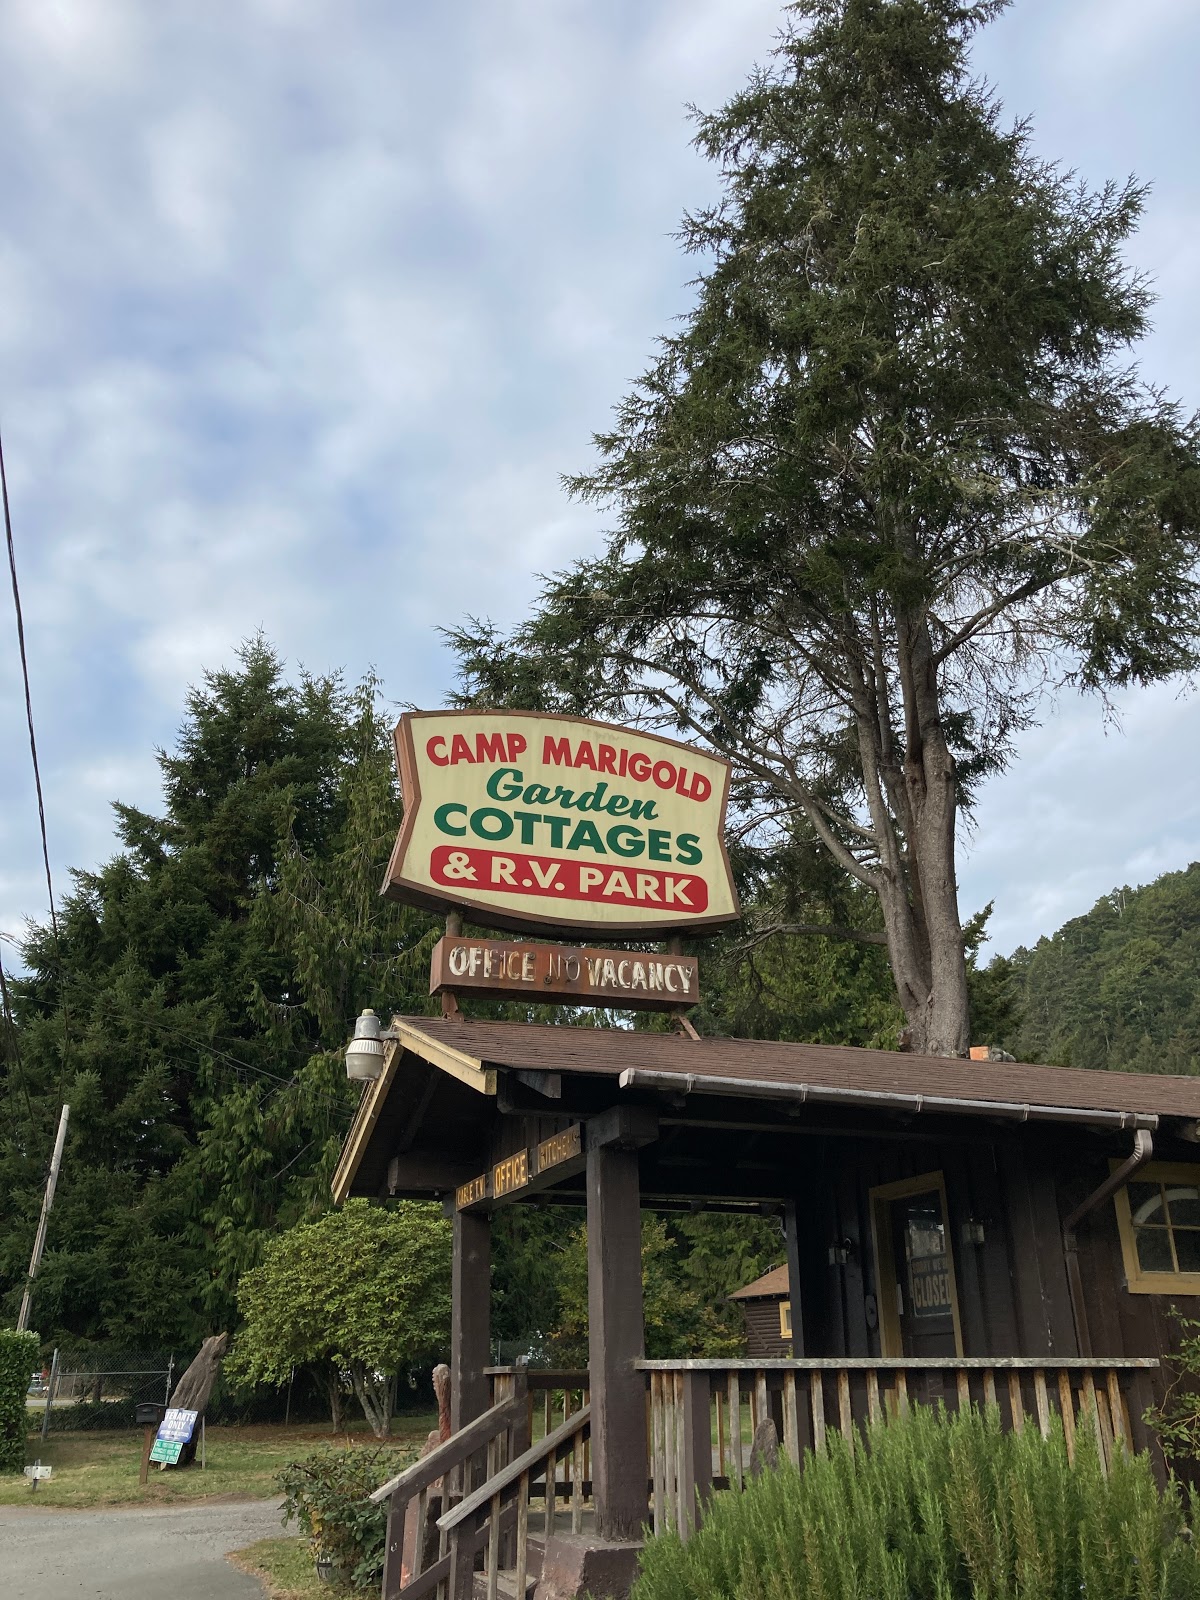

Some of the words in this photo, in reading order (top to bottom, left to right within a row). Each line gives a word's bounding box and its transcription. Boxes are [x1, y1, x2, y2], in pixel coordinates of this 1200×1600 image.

[426, 733, 528, 766] CAMP
[542, 735, 712, 803] MARIGOLD
[486, 767, 659, 821] Garden
[433, 802, 703, 866] COTTAGES
[442, 851, 478, 882] &
[490, 856, 565, 891] R.V.
[579, 866, 695, 906] PARK
[449, 946, 535, 982] OFFICE
[585, 956, 695, 994] VACANCY
[495, 1154, 527, 1194] OFFICE
[914, 1273, 950, 1309] CLOSED
[165, 1411, 196, 1422] TENANTS
[168, 1420, 186, 1430] ONLY
